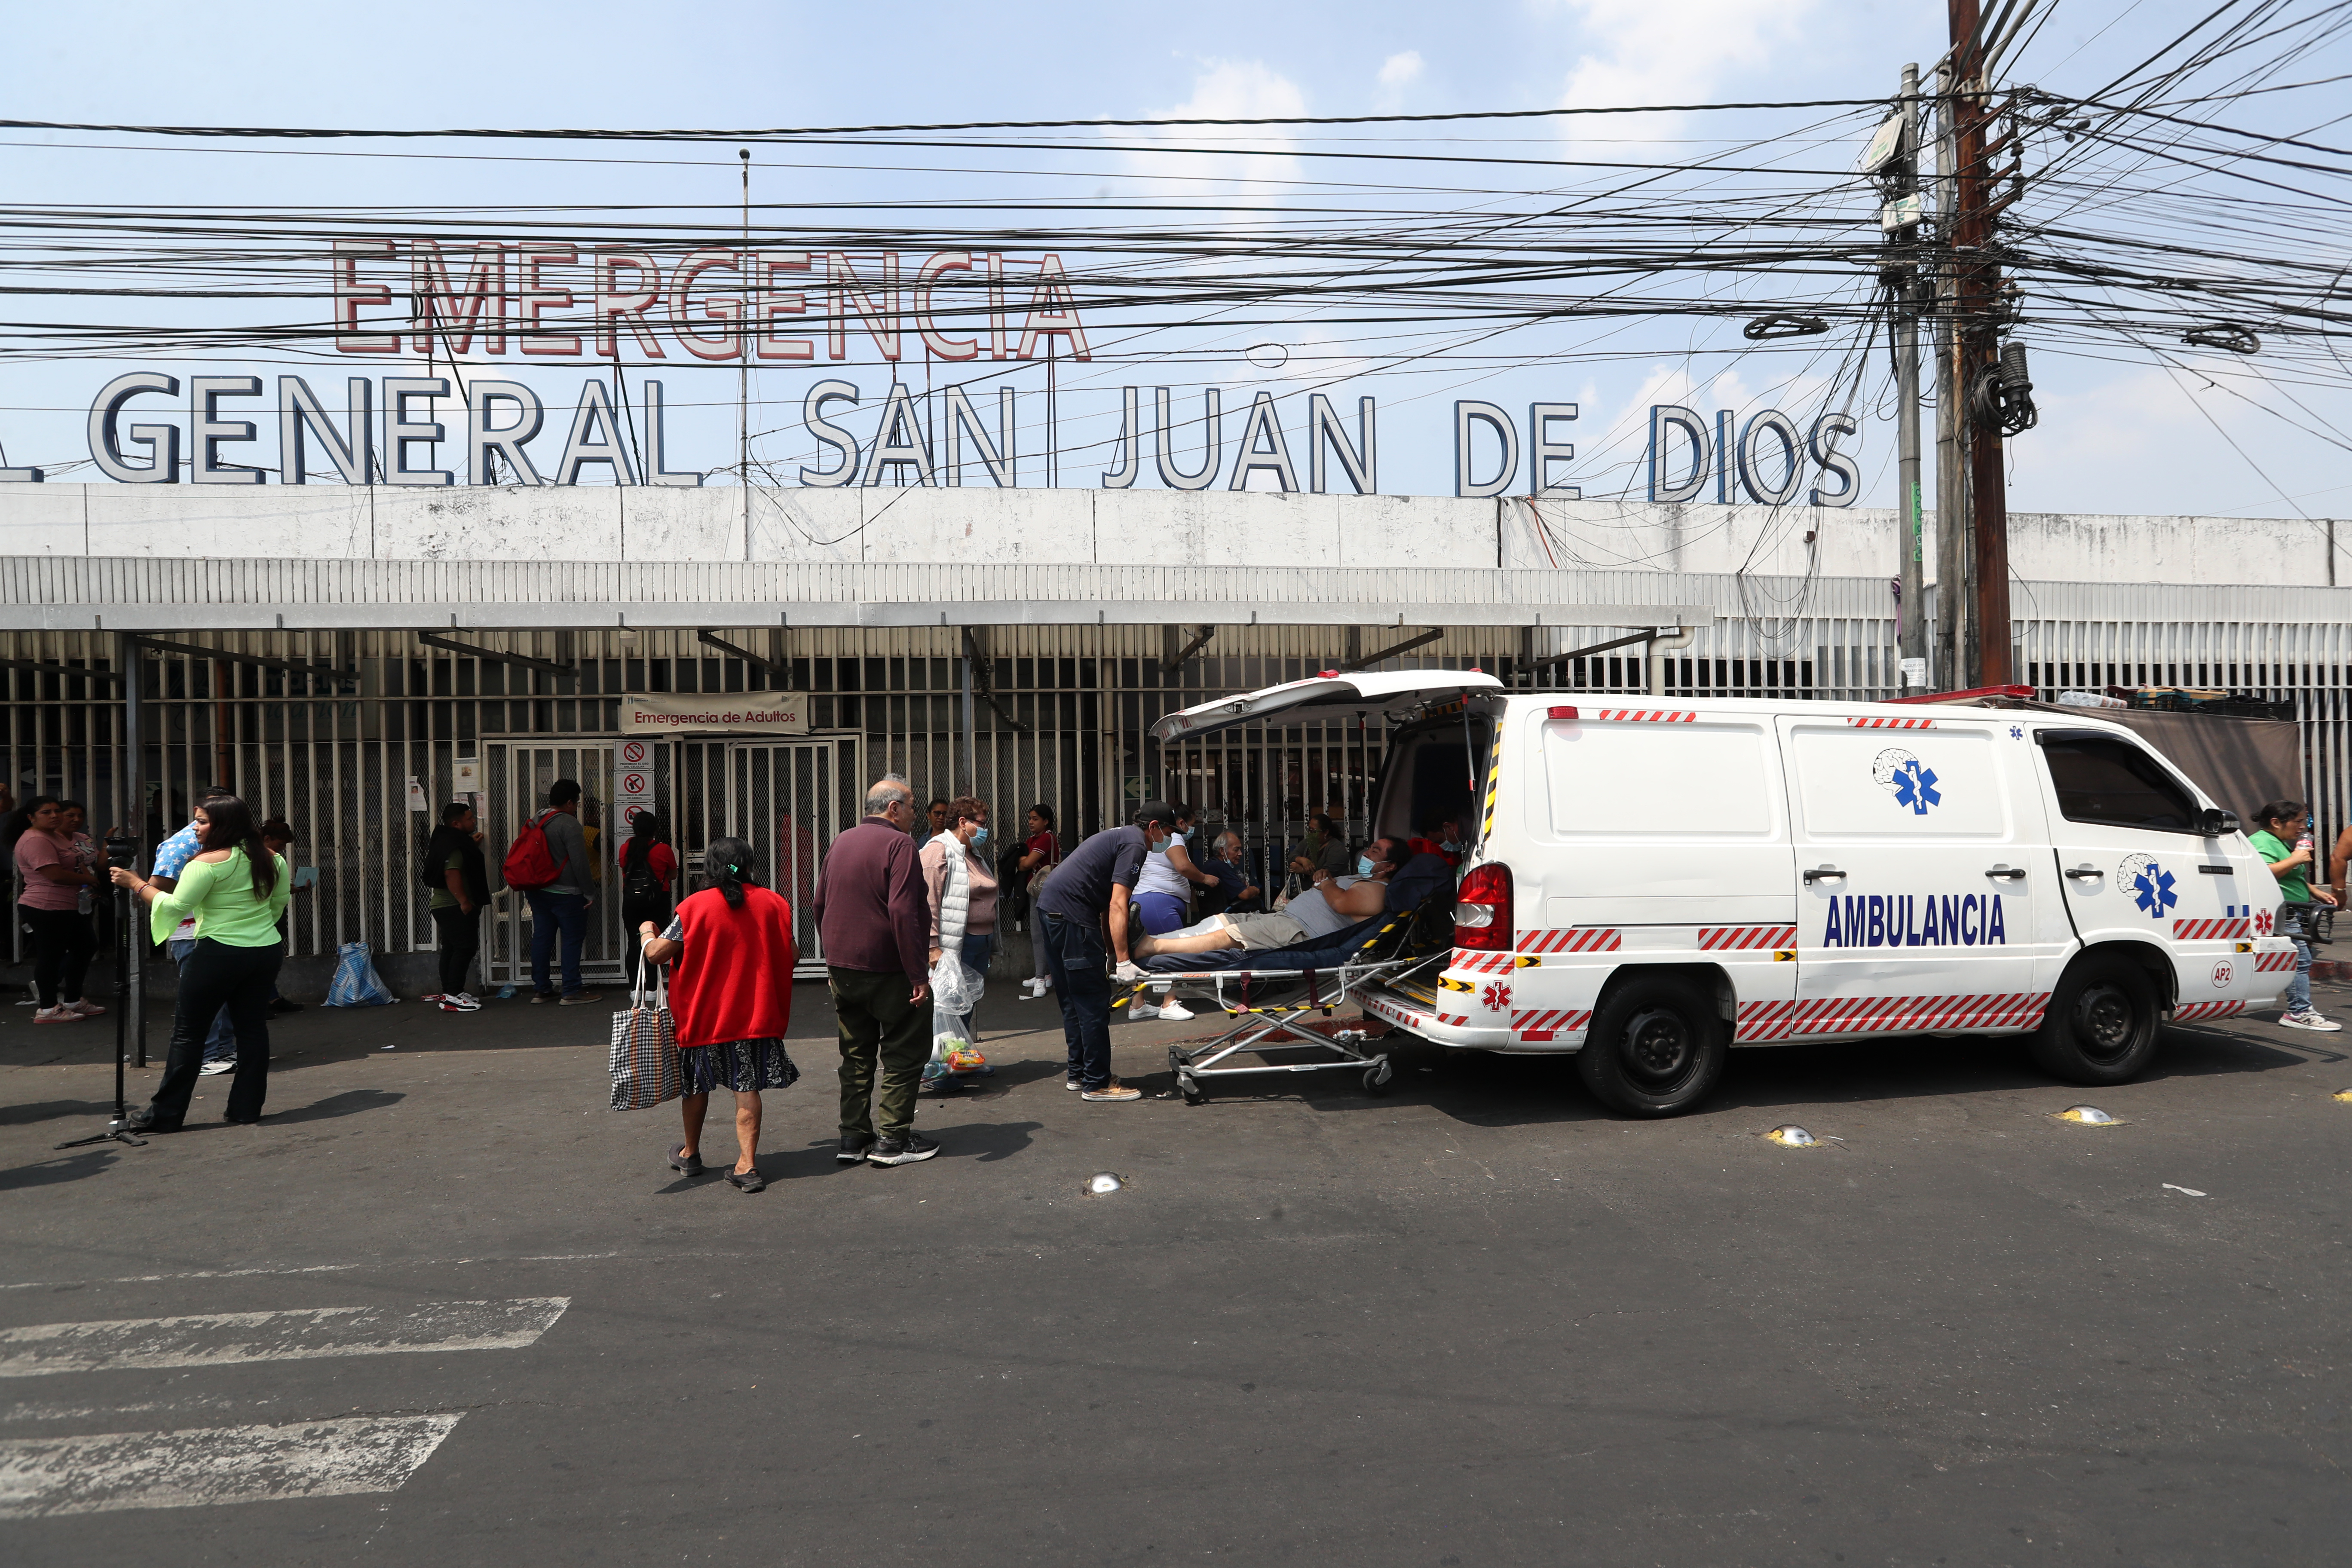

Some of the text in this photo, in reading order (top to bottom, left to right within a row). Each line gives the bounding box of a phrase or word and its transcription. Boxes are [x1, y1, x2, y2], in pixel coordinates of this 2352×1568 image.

[333, 239, 1092, 361] EMERGENCIA
[87, 371, 1861, 508] GENERAL SAN JUAN DE DIOS
[635, 711, 719, 726] Emergencia
[722, 711, 741, 723] de
[744, 710, 796, 723] Adultos
[1194, 888, 1205, 897] rive
[1823, 894, 2006, 948] AMBULANCIA
[2214, 968, 2231, 981] AP2
